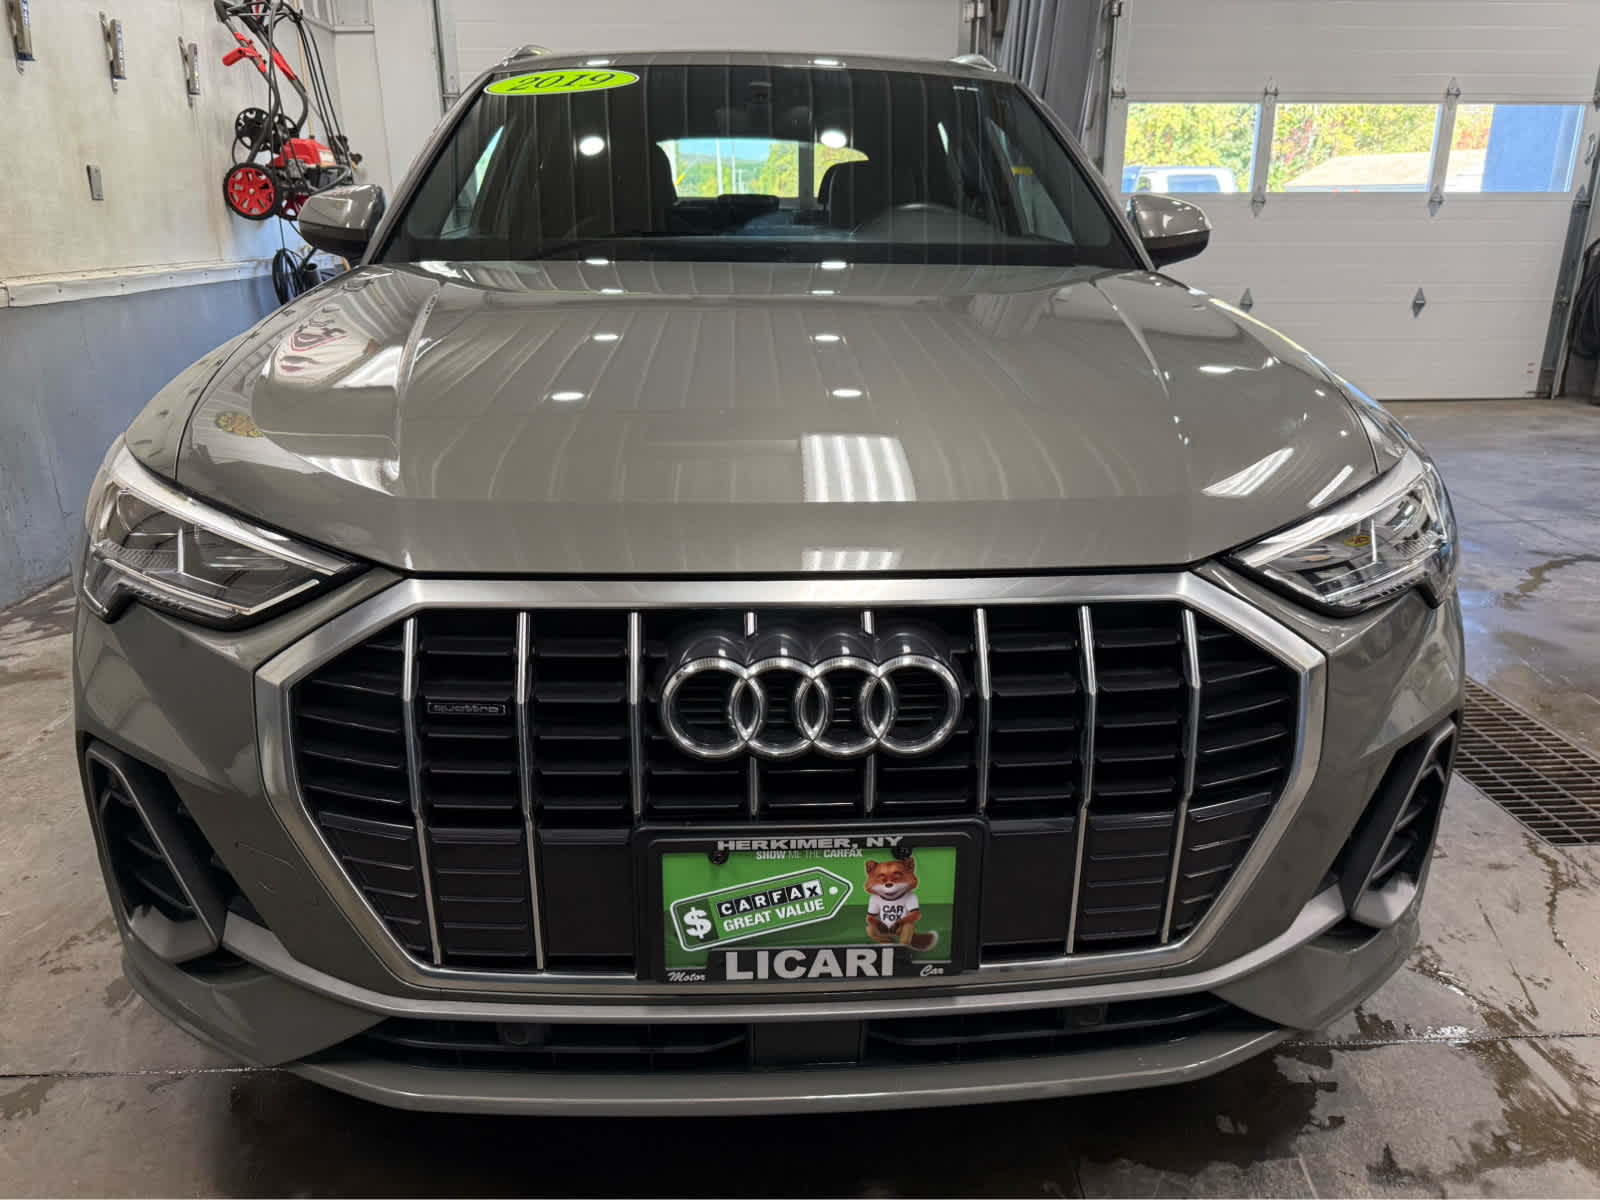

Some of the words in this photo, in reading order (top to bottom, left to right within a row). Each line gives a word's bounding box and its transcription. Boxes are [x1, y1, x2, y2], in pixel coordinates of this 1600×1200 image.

[506, 73, 616, 92] 2019
[717, 838, 858, 850] HERKIMER,
[866, 836, 903, 847] NY
[756, 850, 786, 860] SHOW
[823, 848, 863, 858] CARFAX
[719, 882, 821, 916] CARFAX
[723, 910, 771, 932] GREAT
[776, 899, 825, 919] VALUE
[882, 905, 904, 914] CAR
[882, 913, 902, 921] FOX
[725, 948, 894, 981] LICARI
[920, 964, 944, 977] Car
[667, 971, 706, 982] Motor
